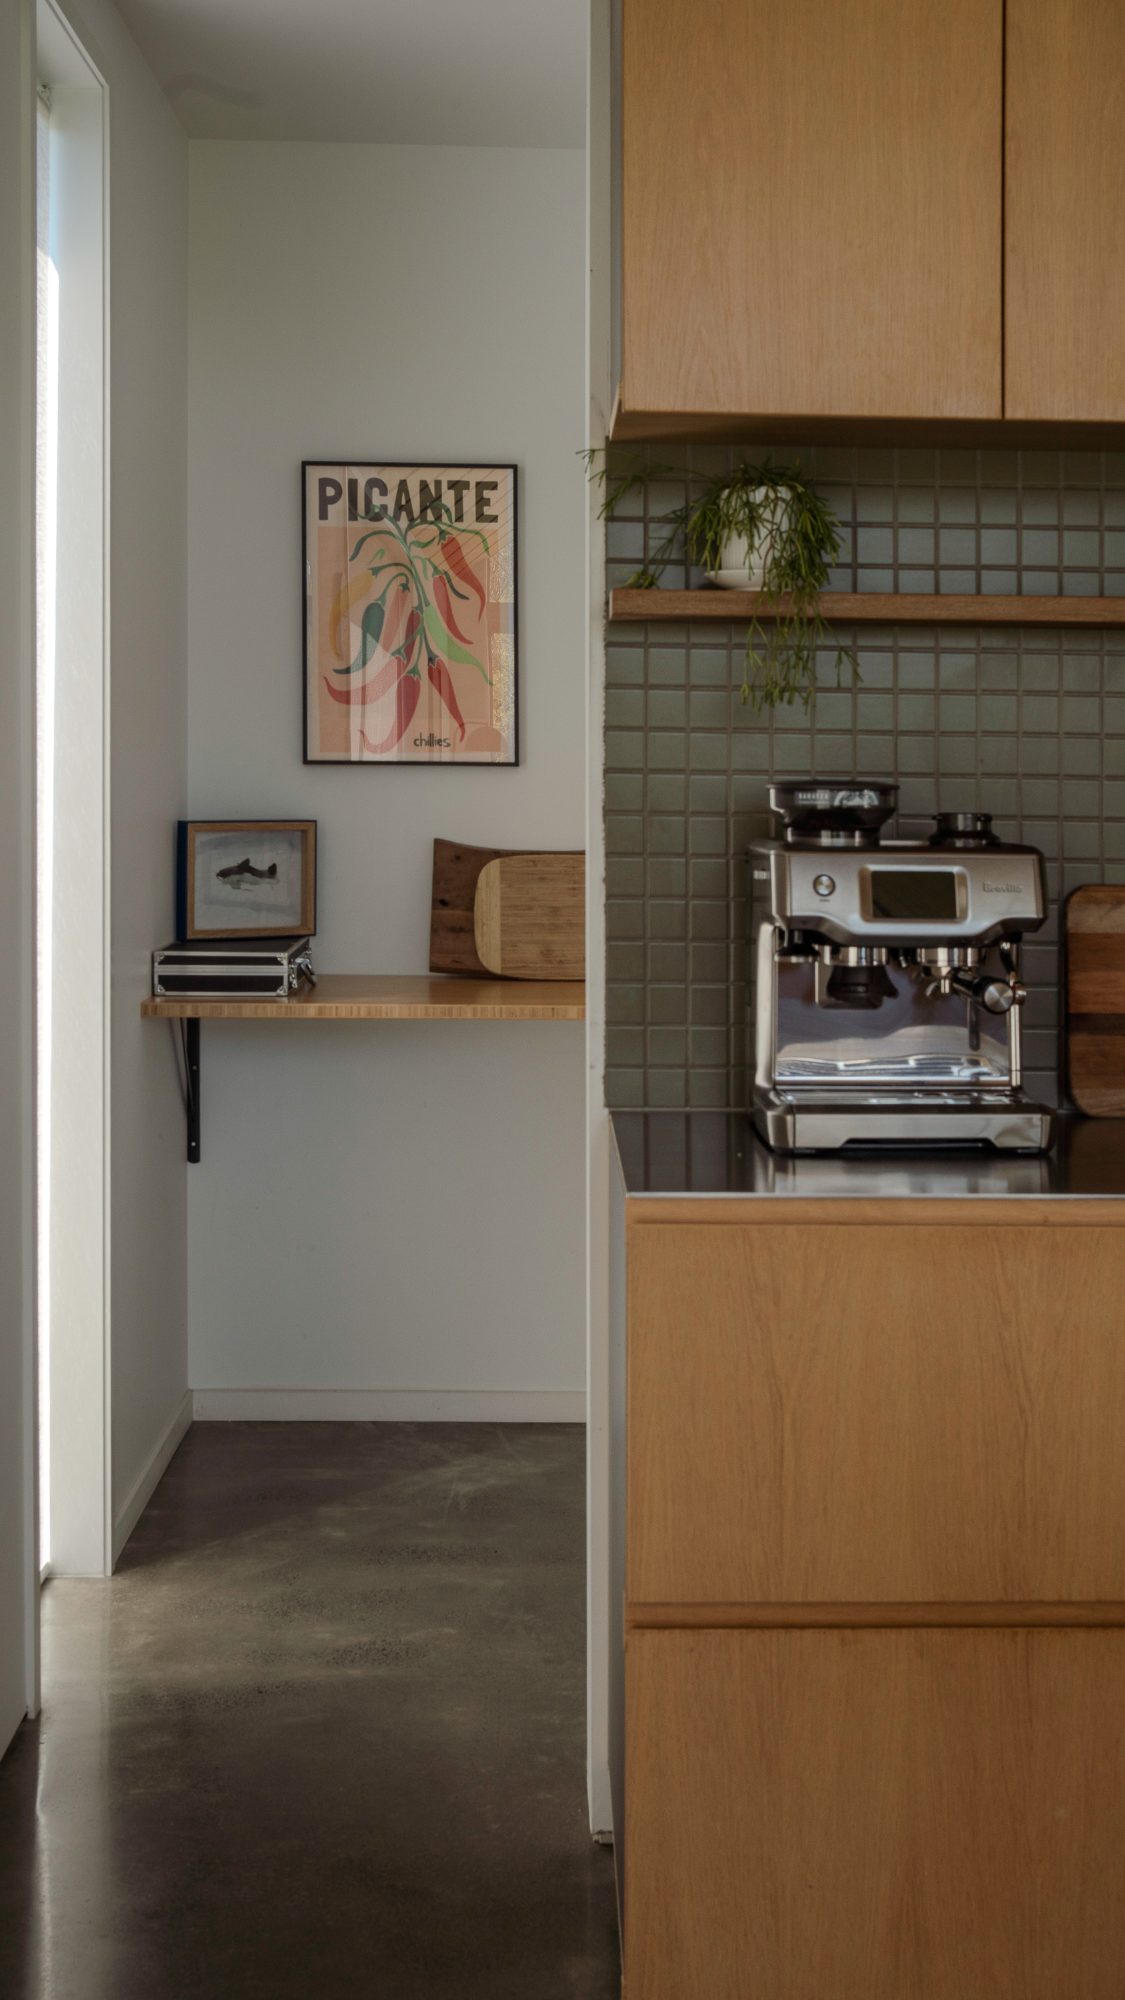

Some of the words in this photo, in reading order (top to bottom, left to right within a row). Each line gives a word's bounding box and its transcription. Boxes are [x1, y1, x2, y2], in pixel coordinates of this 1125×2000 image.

[318, 477, 499, 523] PICANTE
[413, 731, 451, 748] chillies
[982, 880, 1023, 893] Breville
